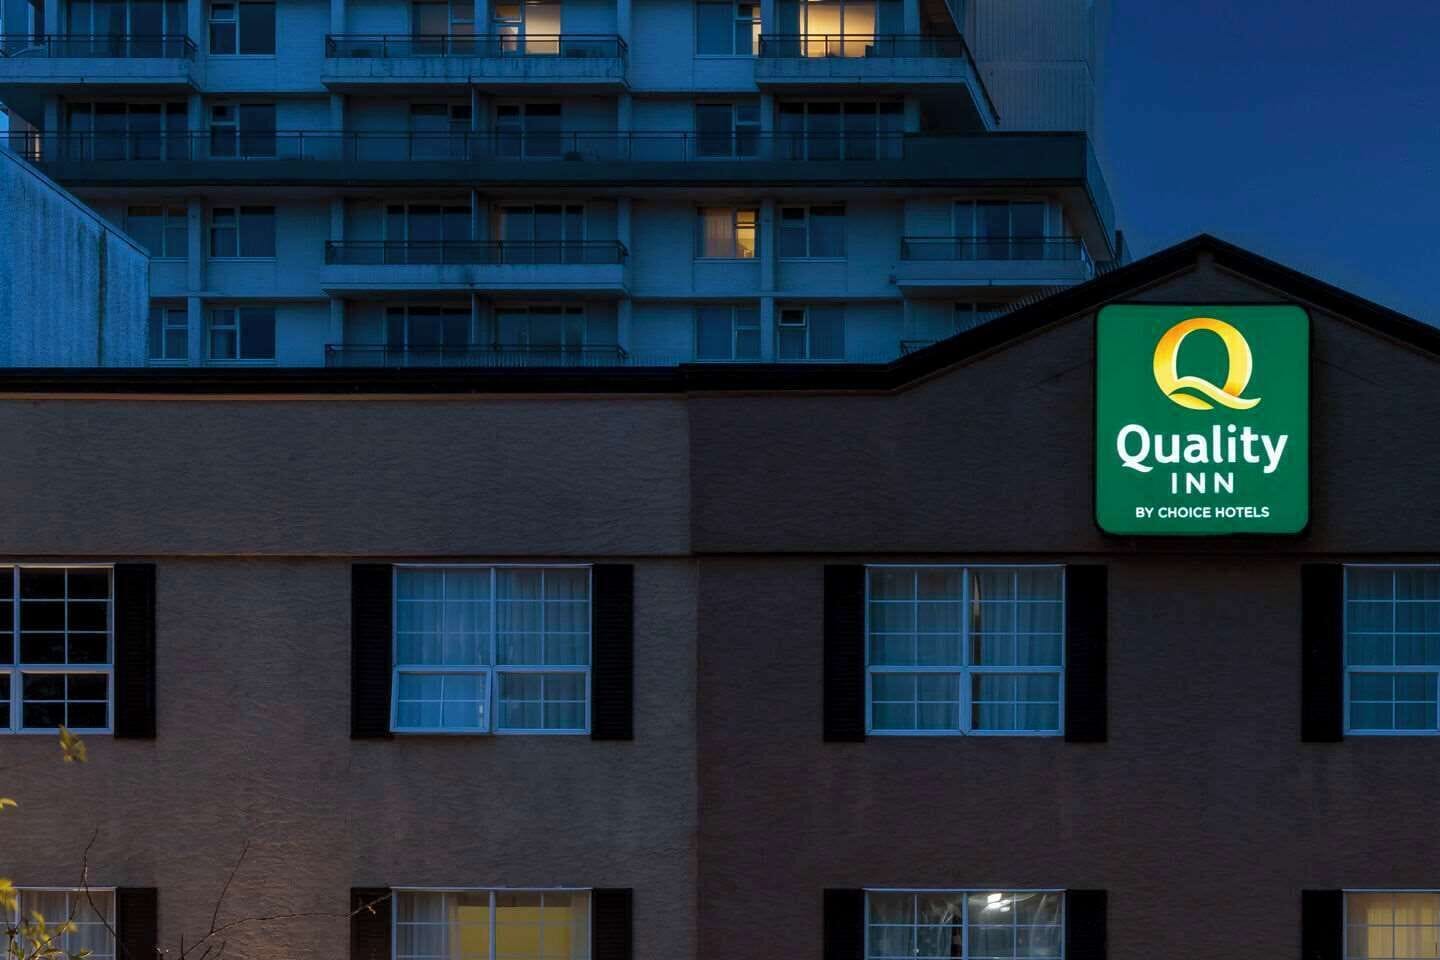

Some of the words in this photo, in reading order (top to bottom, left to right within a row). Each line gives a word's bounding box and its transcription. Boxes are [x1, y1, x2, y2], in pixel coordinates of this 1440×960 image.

[1153, 317, 1262, 411] Q
[1116, 423, 1289, 474] Quality
[1170, 472, 1234, 494] INN
[1135, 507, 1154, 518] BY
[1158, 506, 1211, 518] CHOICE
[1215, 506, 1270, 518] HOTELS
